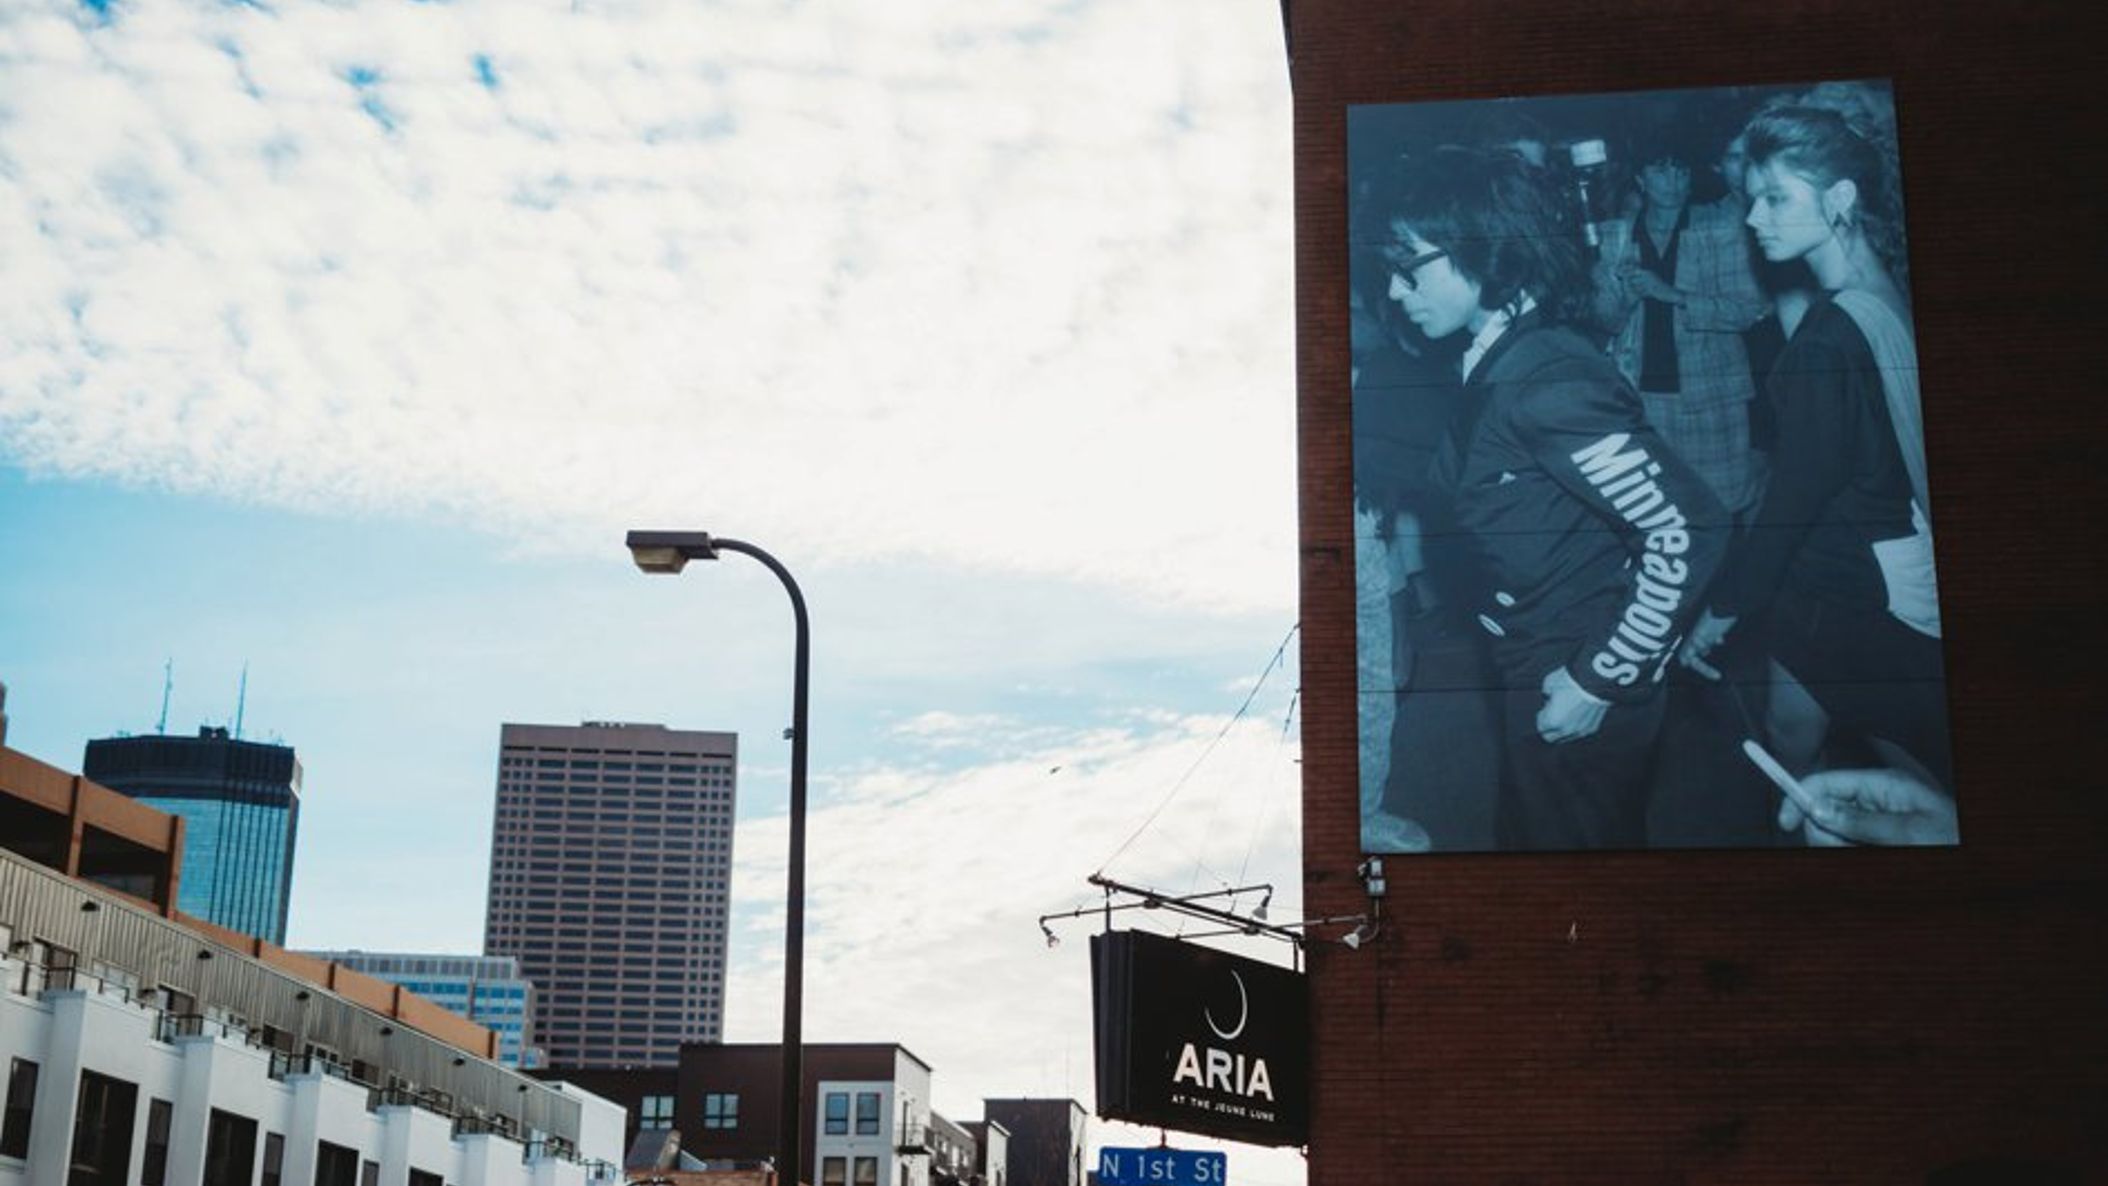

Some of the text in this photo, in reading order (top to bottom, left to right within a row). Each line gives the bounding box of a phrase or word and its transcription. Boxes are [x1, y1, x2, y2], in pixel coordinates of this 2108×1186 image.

[1570, 433, 1690, 685] Minneapolis
[1173, 1042, 1274, 1101] ARIA
[1171, 1094, 1275, 1122] AT THE JEUNE LUNE
[1102, 1153, 1222, 1182] N 1st St
